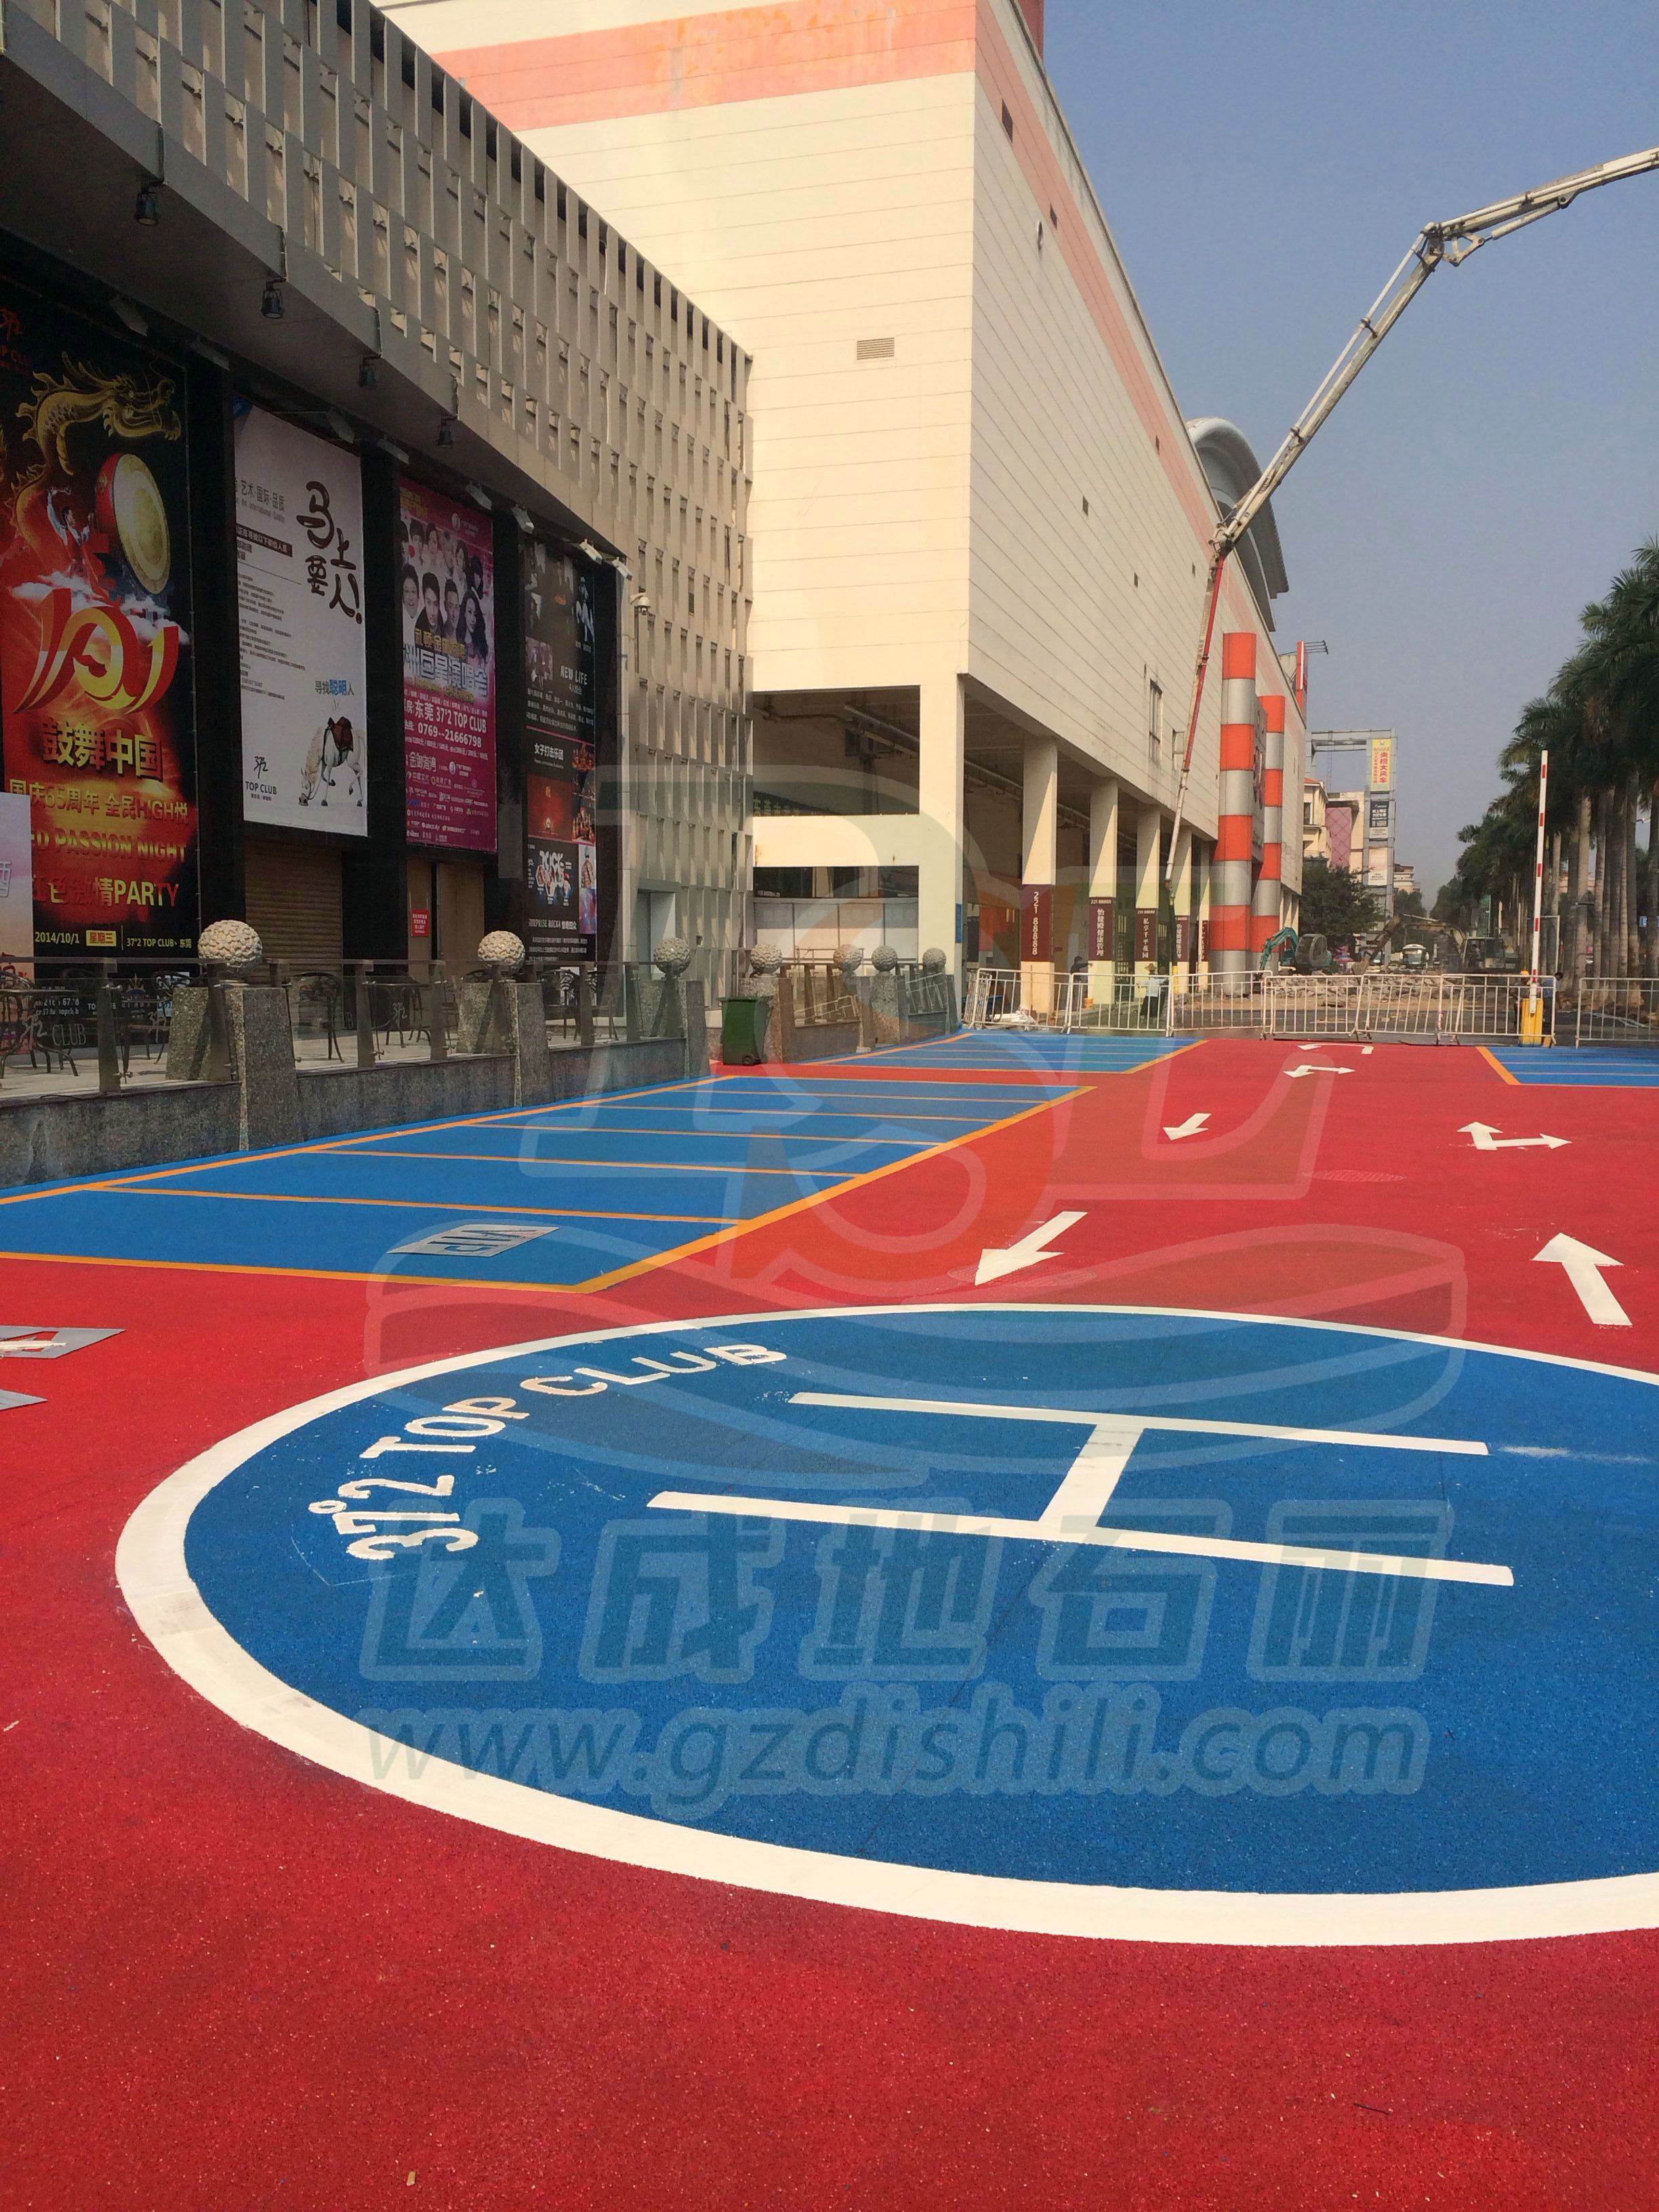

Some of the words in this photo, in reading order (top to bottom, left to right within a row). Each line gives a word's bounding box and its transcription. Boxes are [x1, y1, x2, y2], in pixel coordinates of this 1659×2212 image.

[560, 665, 573, 681] NEW
[575, 670, 588, 686] LIFE
[314, 679, 354, 696] 寻找聪明人
[453, 711, 468, 729] TOP
[469, 715, 487, 733] CLUB
[42, 718, 163, 781] 鼓舞中国
[245, 781, 259, 792] TOP
[260, 783, 277, 795] CLUB
[55, 827, 133, 860] PASSION
[137, 840, 187, 863] NIGHT
[35, 931, 80, 944] 2014/10/1
[89, 932, 114, 945] 星期三
[143, 938, 157, 947] TOP
[52, 1024, 86, 1046] CLUB
[359, 1396, 530, 1458] TOP
[519, 1343, 787, 1396] CLUB
